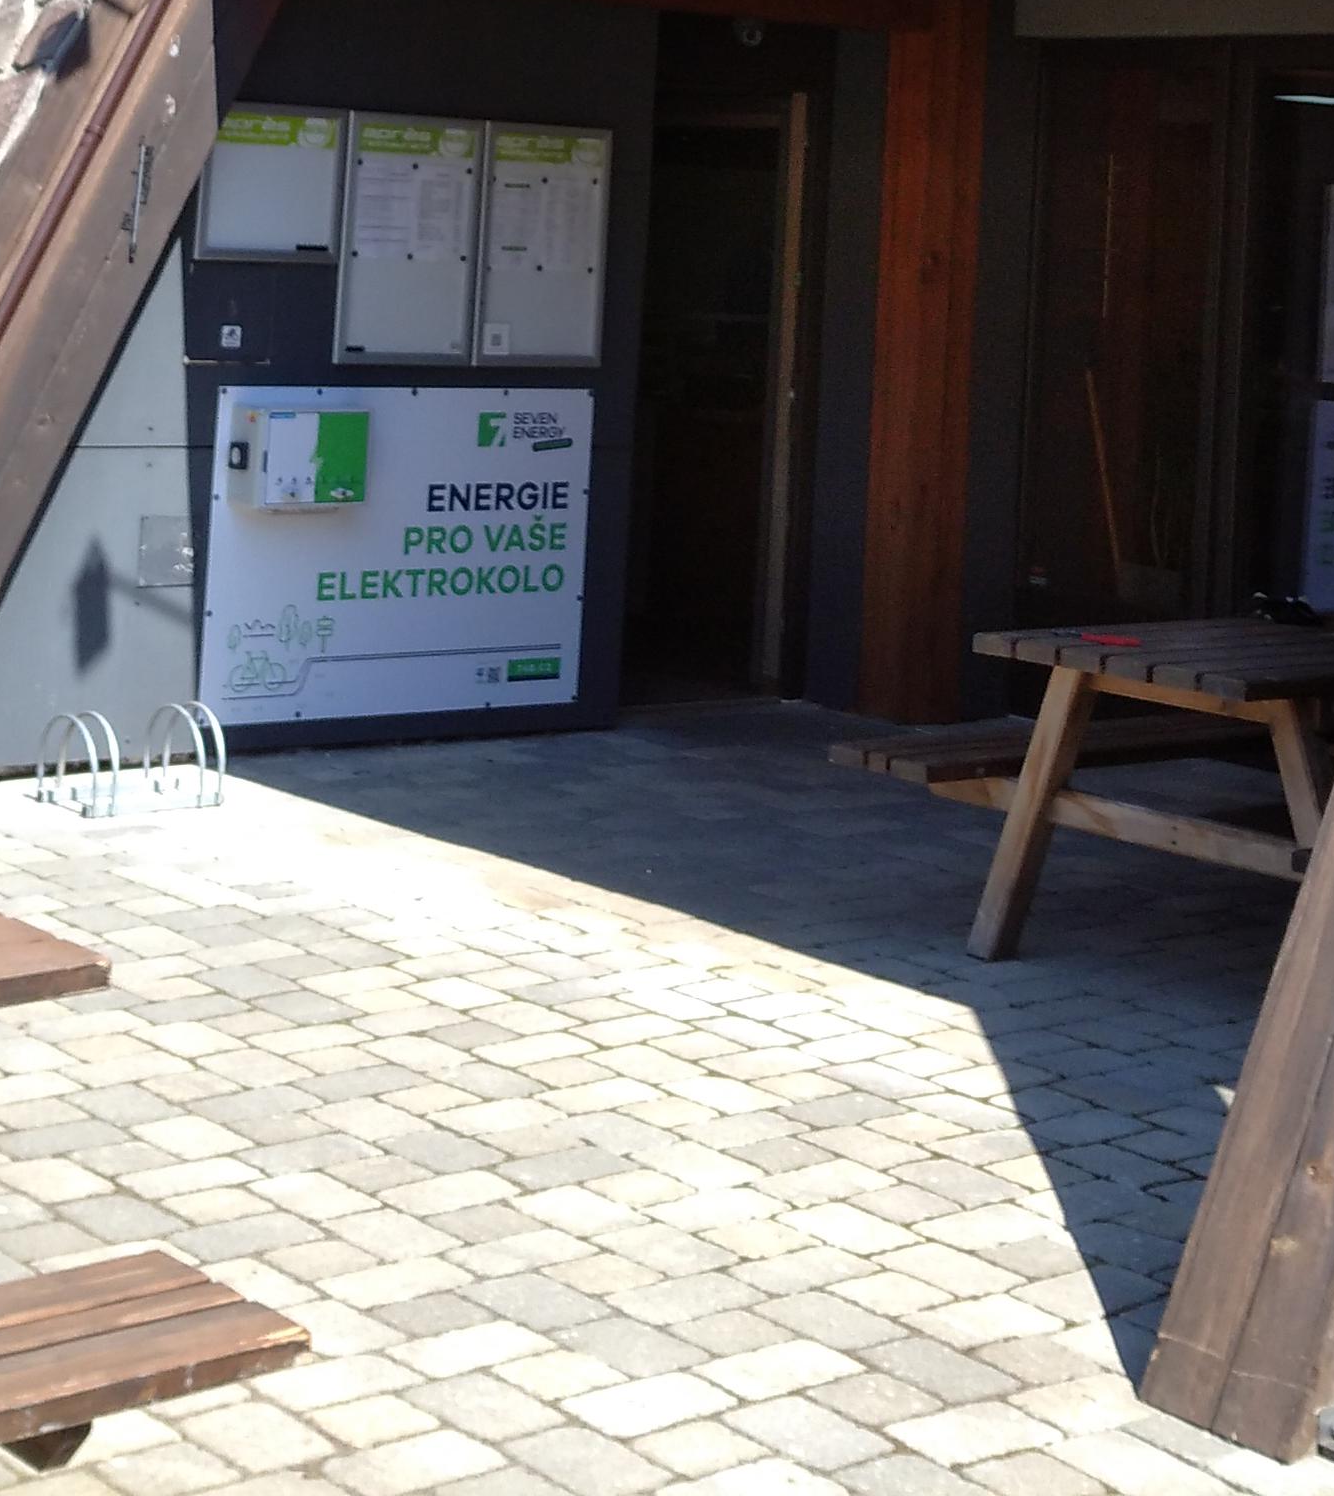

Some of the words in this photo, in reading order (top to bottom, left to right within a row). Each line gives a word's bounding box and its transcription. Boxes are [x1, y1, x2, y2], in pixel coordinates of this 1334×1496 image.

[512, 425, 566, 439] ENERGY
[513, 411, 558, 425] SEVEN
[426, 481, 569, 512] ENERGIE
[403, 524, 473, 555] PRO
[483, 515, 568, 553] VAŠE
[316, 563, 565, 602] ELEKTROKOLO
